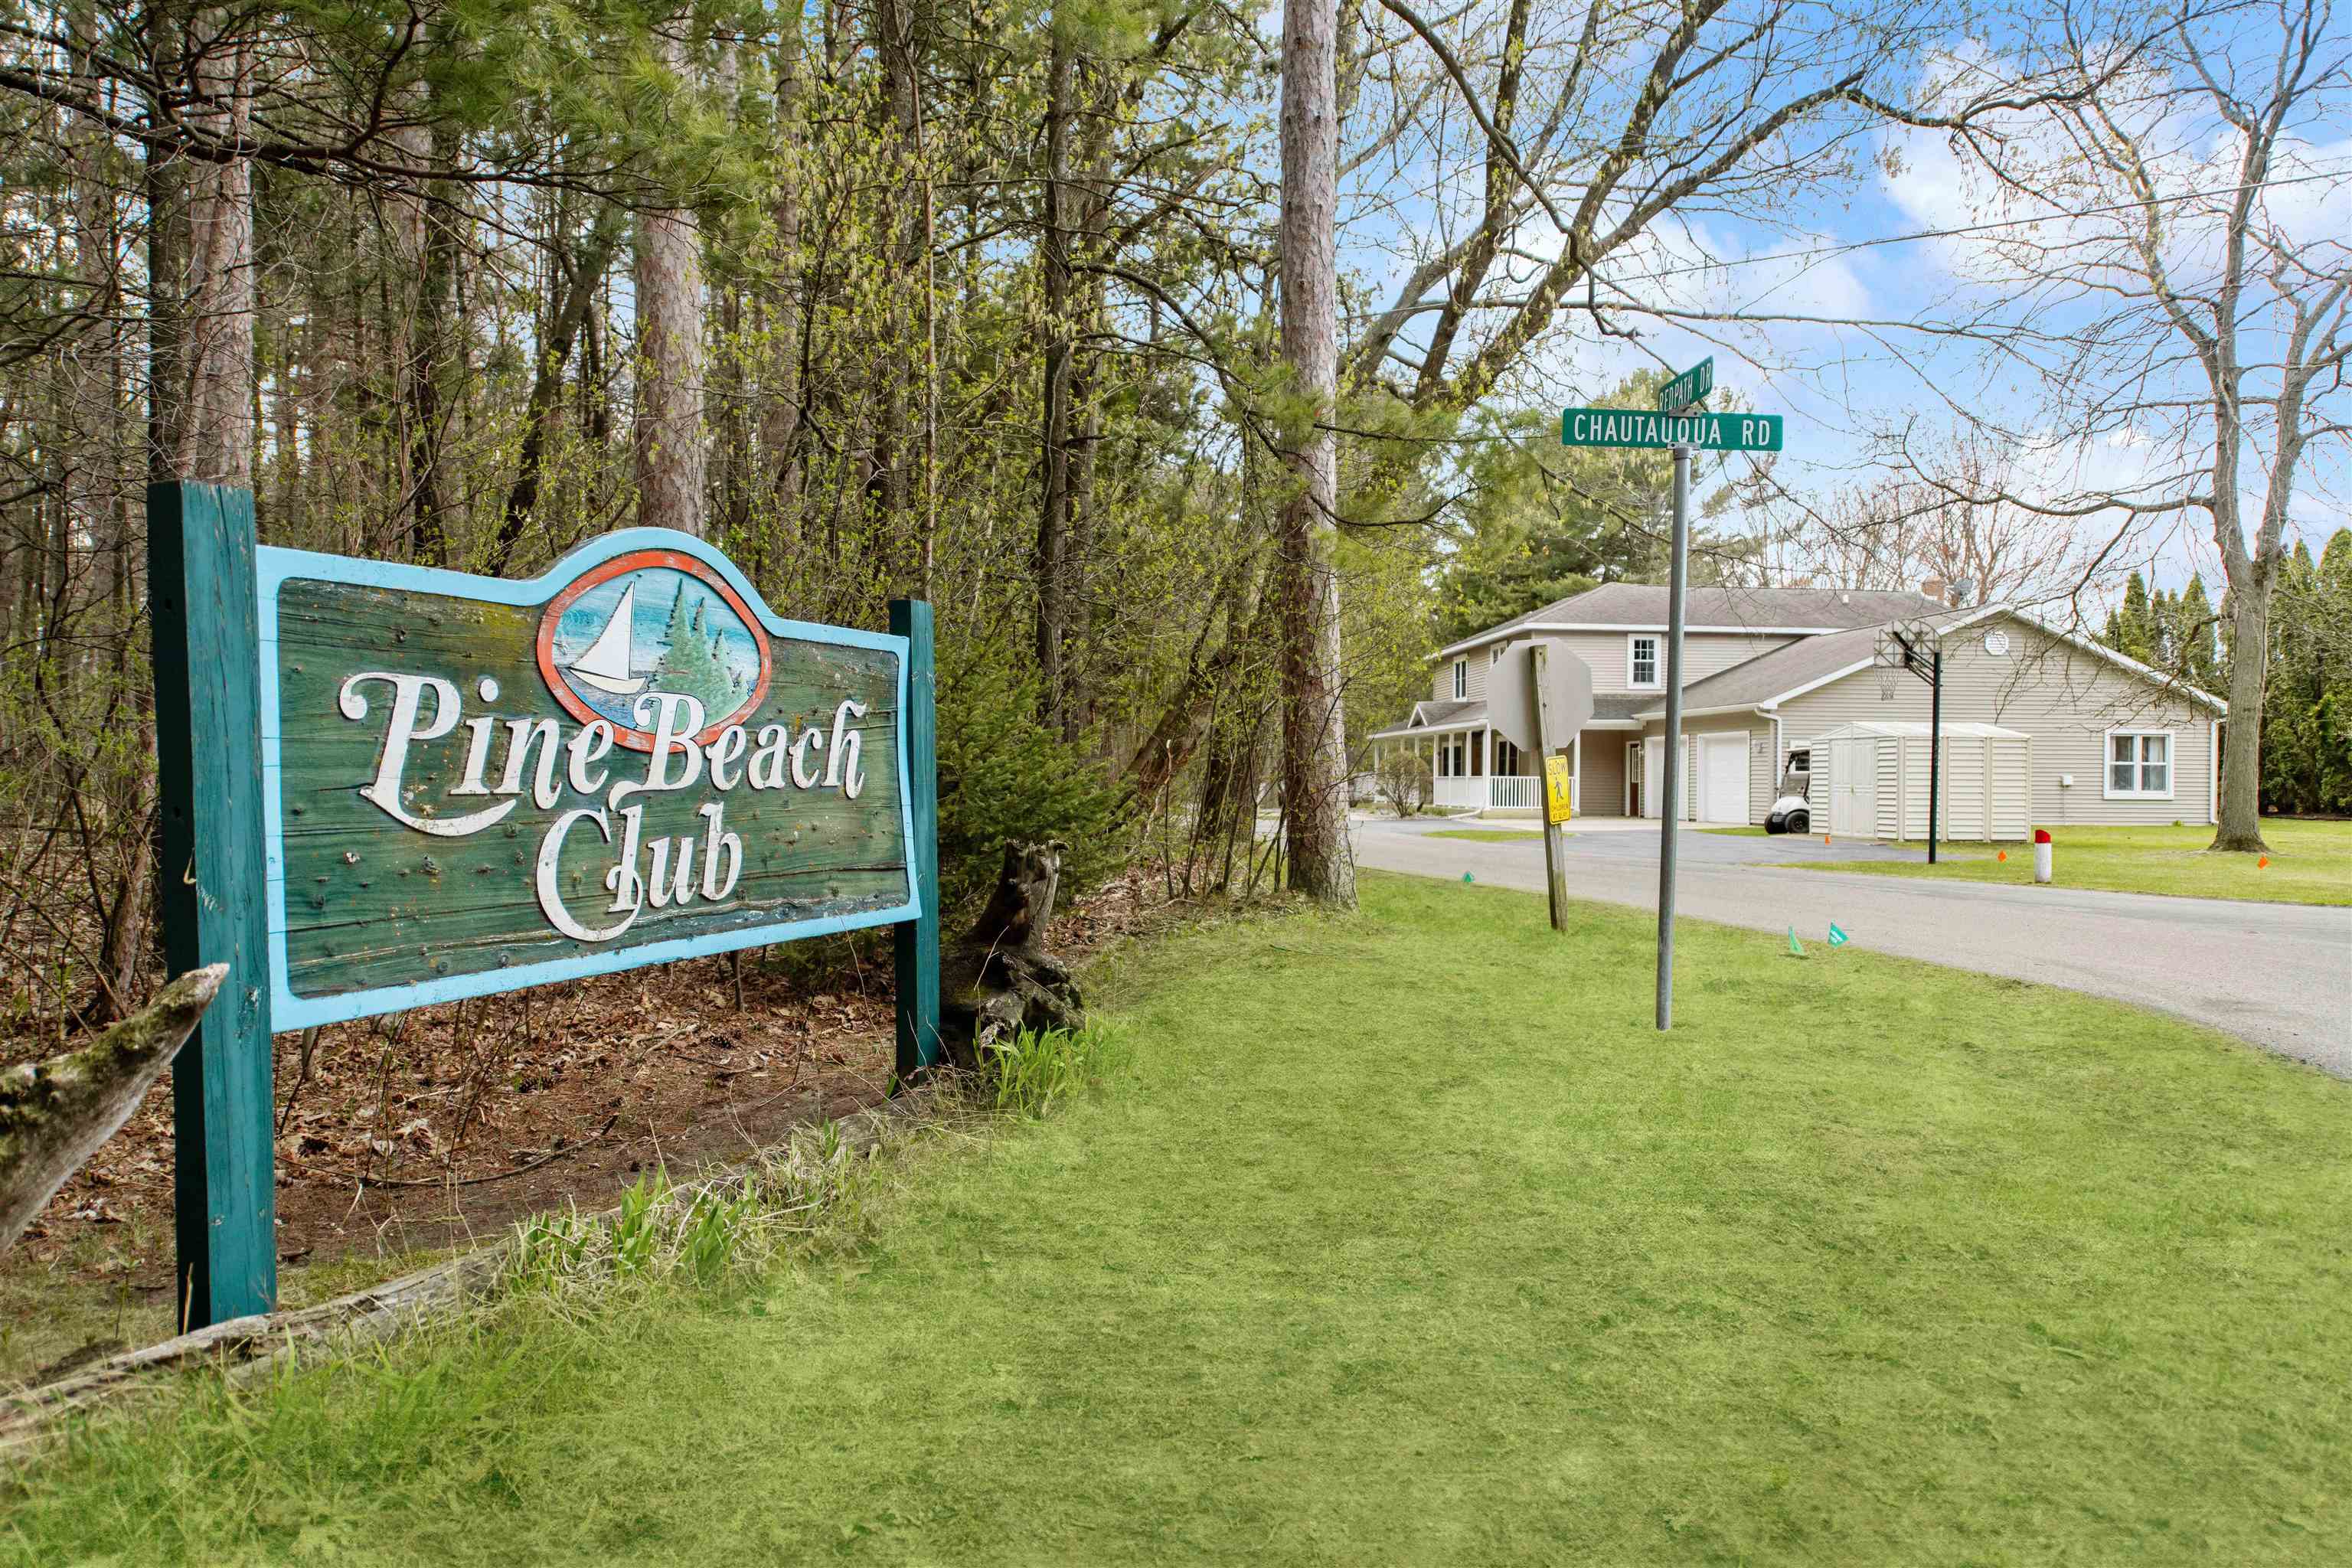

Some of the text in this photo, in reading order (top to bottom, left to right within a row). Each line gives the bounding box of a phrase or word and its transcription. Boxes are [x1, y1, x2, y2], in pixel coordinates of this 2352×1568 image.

[1658, 362, 1712, 412] REDPATH DR
[1573, 413, 1770, 446] CHAUTAUQUA RD
[339, 671, 867, 837] Pine Beach
[1548, 758, 1567, 776] SLOW
[536, 801, 743, 942] Club
